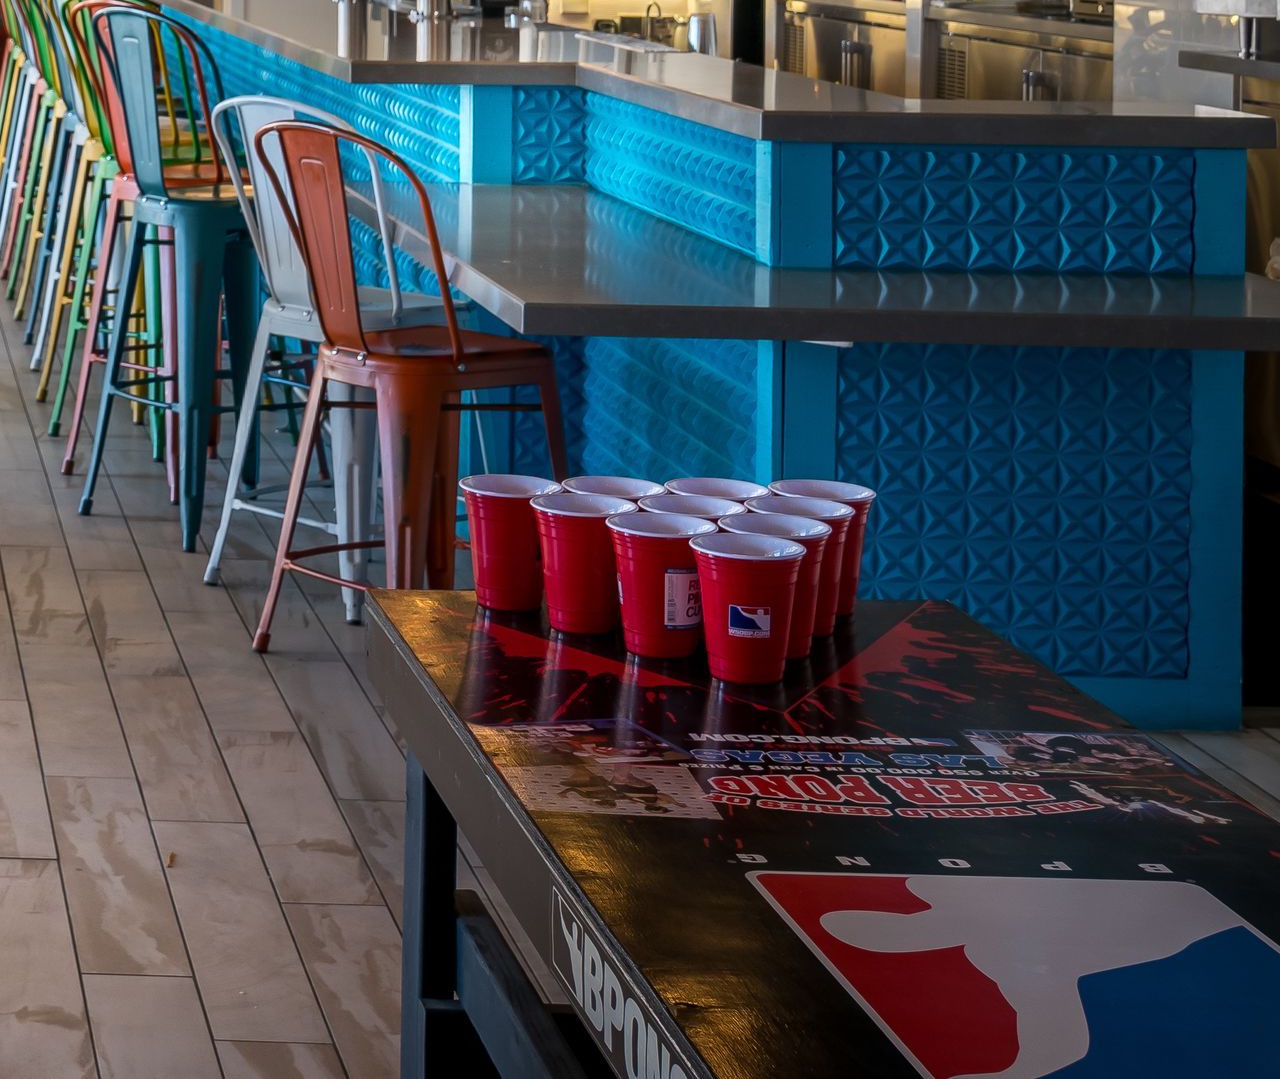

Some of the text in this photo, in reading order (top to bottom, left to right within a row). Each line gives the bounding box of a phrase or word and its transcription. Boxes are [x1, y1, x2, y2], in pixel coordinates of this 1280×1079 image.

[688, 732, 912, 746] BPONG.COM
[690, 748, 1009, 768] LAS VEGAS
[707, 774, 1056, 805] BEER PONG
[701, 793, 1106, 818] THE WORLD SERIES OF
[584, 932, 687, 1078] BPON
